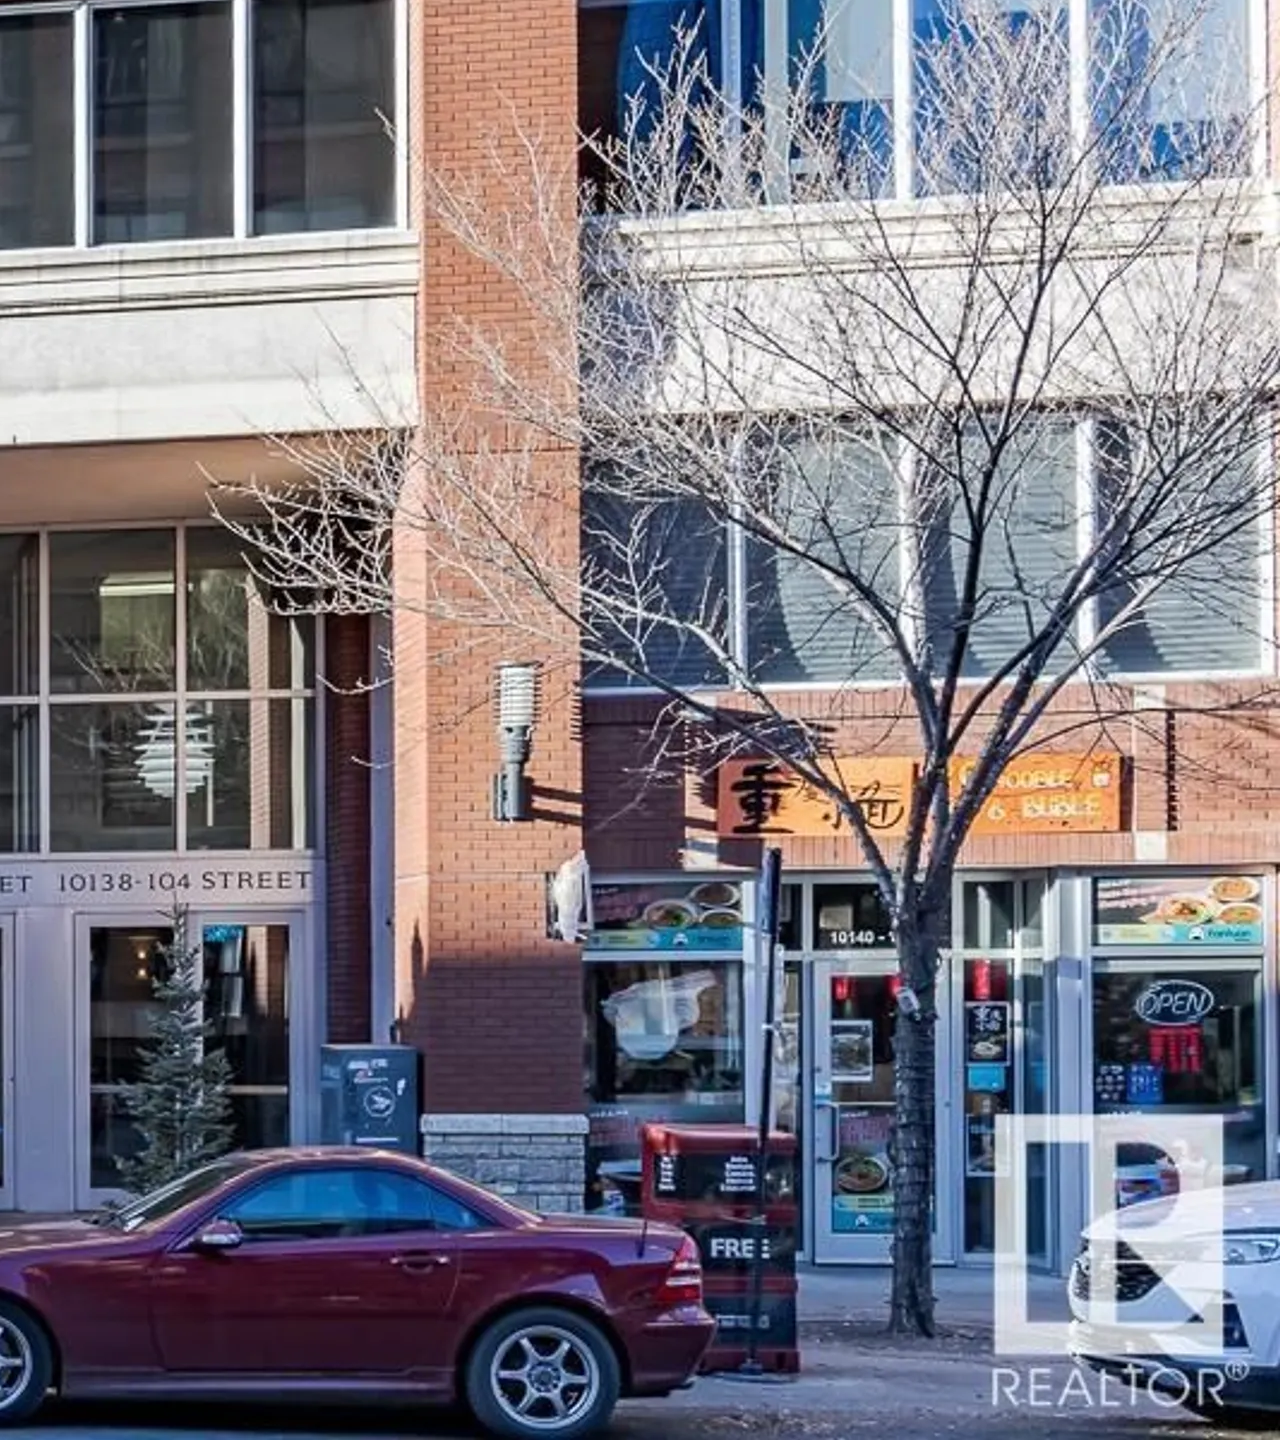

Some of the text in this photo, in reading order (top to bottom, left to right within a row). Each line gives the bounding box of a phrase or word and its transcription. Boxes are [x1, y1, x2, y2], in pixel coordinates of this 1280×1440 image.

[202, 870, 313, 890] STREET
[830, 930, 874, 945] 10140
[1141, 992, 1206, 1015] OPEN
